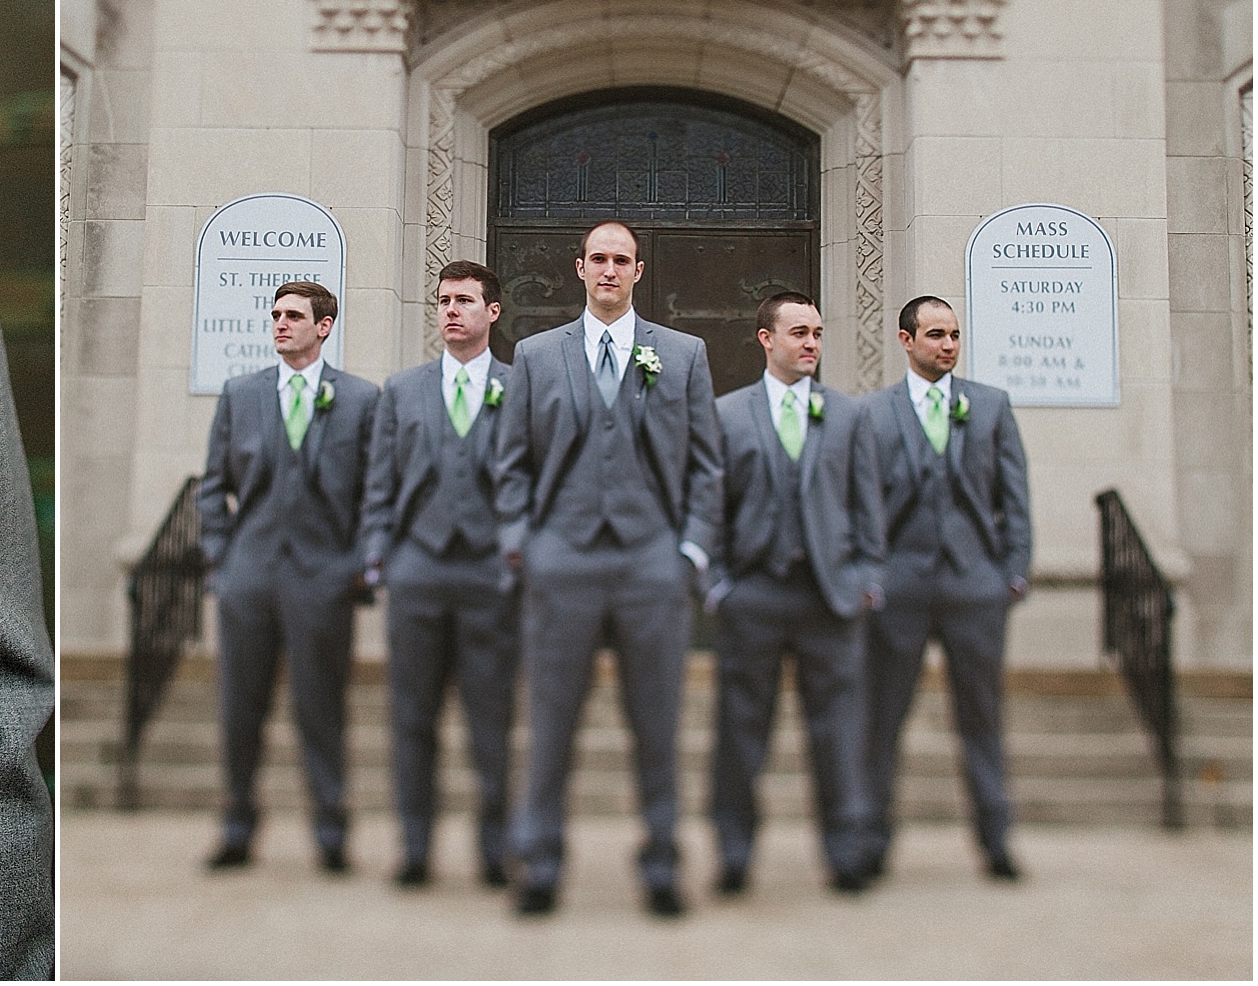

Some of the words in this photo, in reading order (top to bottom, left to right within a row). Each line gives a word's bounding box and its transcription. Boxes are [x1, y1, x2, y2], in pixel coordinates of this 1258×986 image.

[1016, 221, 1068, 236] MASS
[219, 230, 327, 248] WELCOME
[992, 243, 1090, 259] SCHEDULE
[219, 272, 242, 287] ST.
[1000, 280, 1084, 294] SATURDAY
[253, 295, 275, 310] TH
[1011, 301, 1045, 314] 4:30
[1051, 301, 1076, 314] PM
[203, 319, 253, 333] LITTLE
[1008, 334, 1074, 349] SUNDAY
